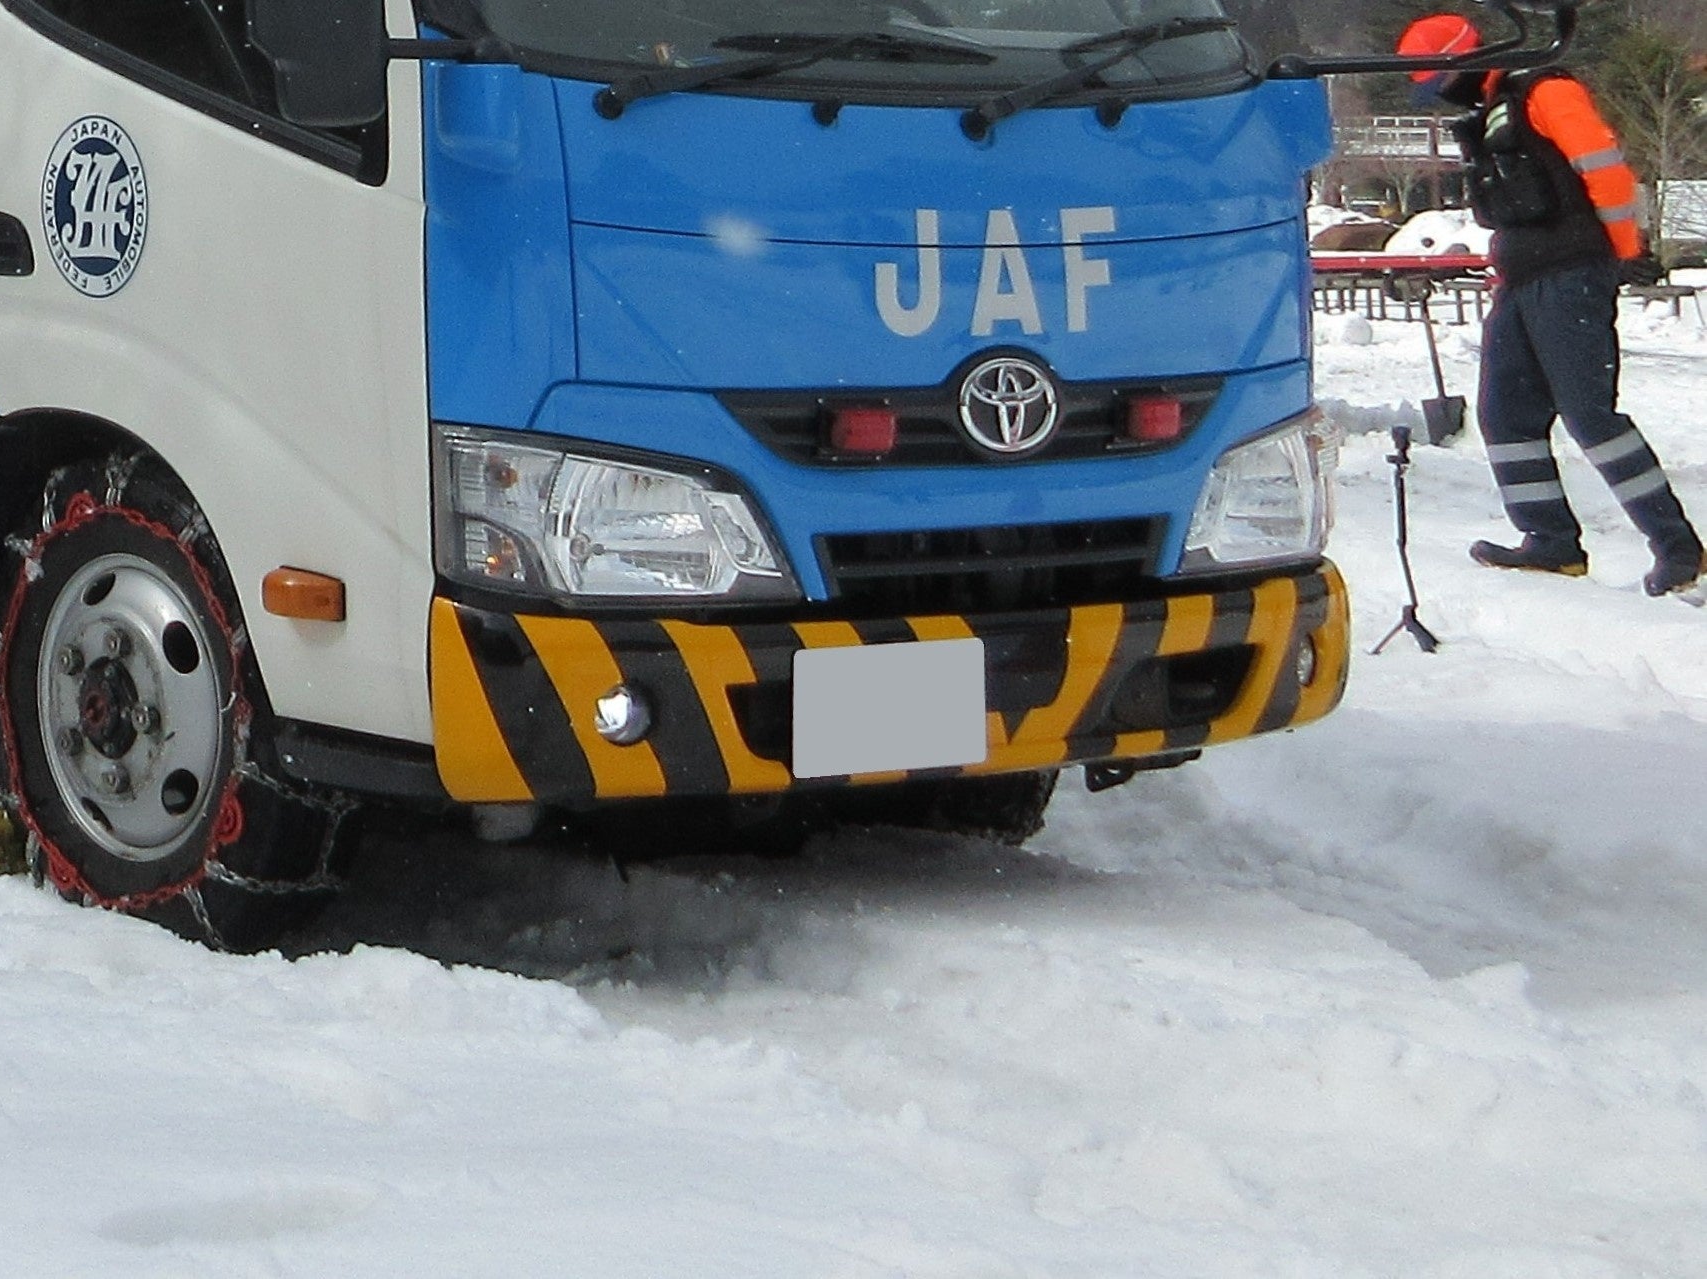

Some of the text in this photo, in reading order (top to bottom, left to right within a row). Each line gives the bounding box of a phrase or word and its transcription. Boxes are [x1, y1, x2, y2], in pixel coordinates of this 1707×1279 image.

[70, 121, 123, 145] JAPAN
[44, 164, 88, 289] FEDERATION
[103, 166, 145, 290] AUTOMOBILE
[874, 206, 1116, 337] JAF
